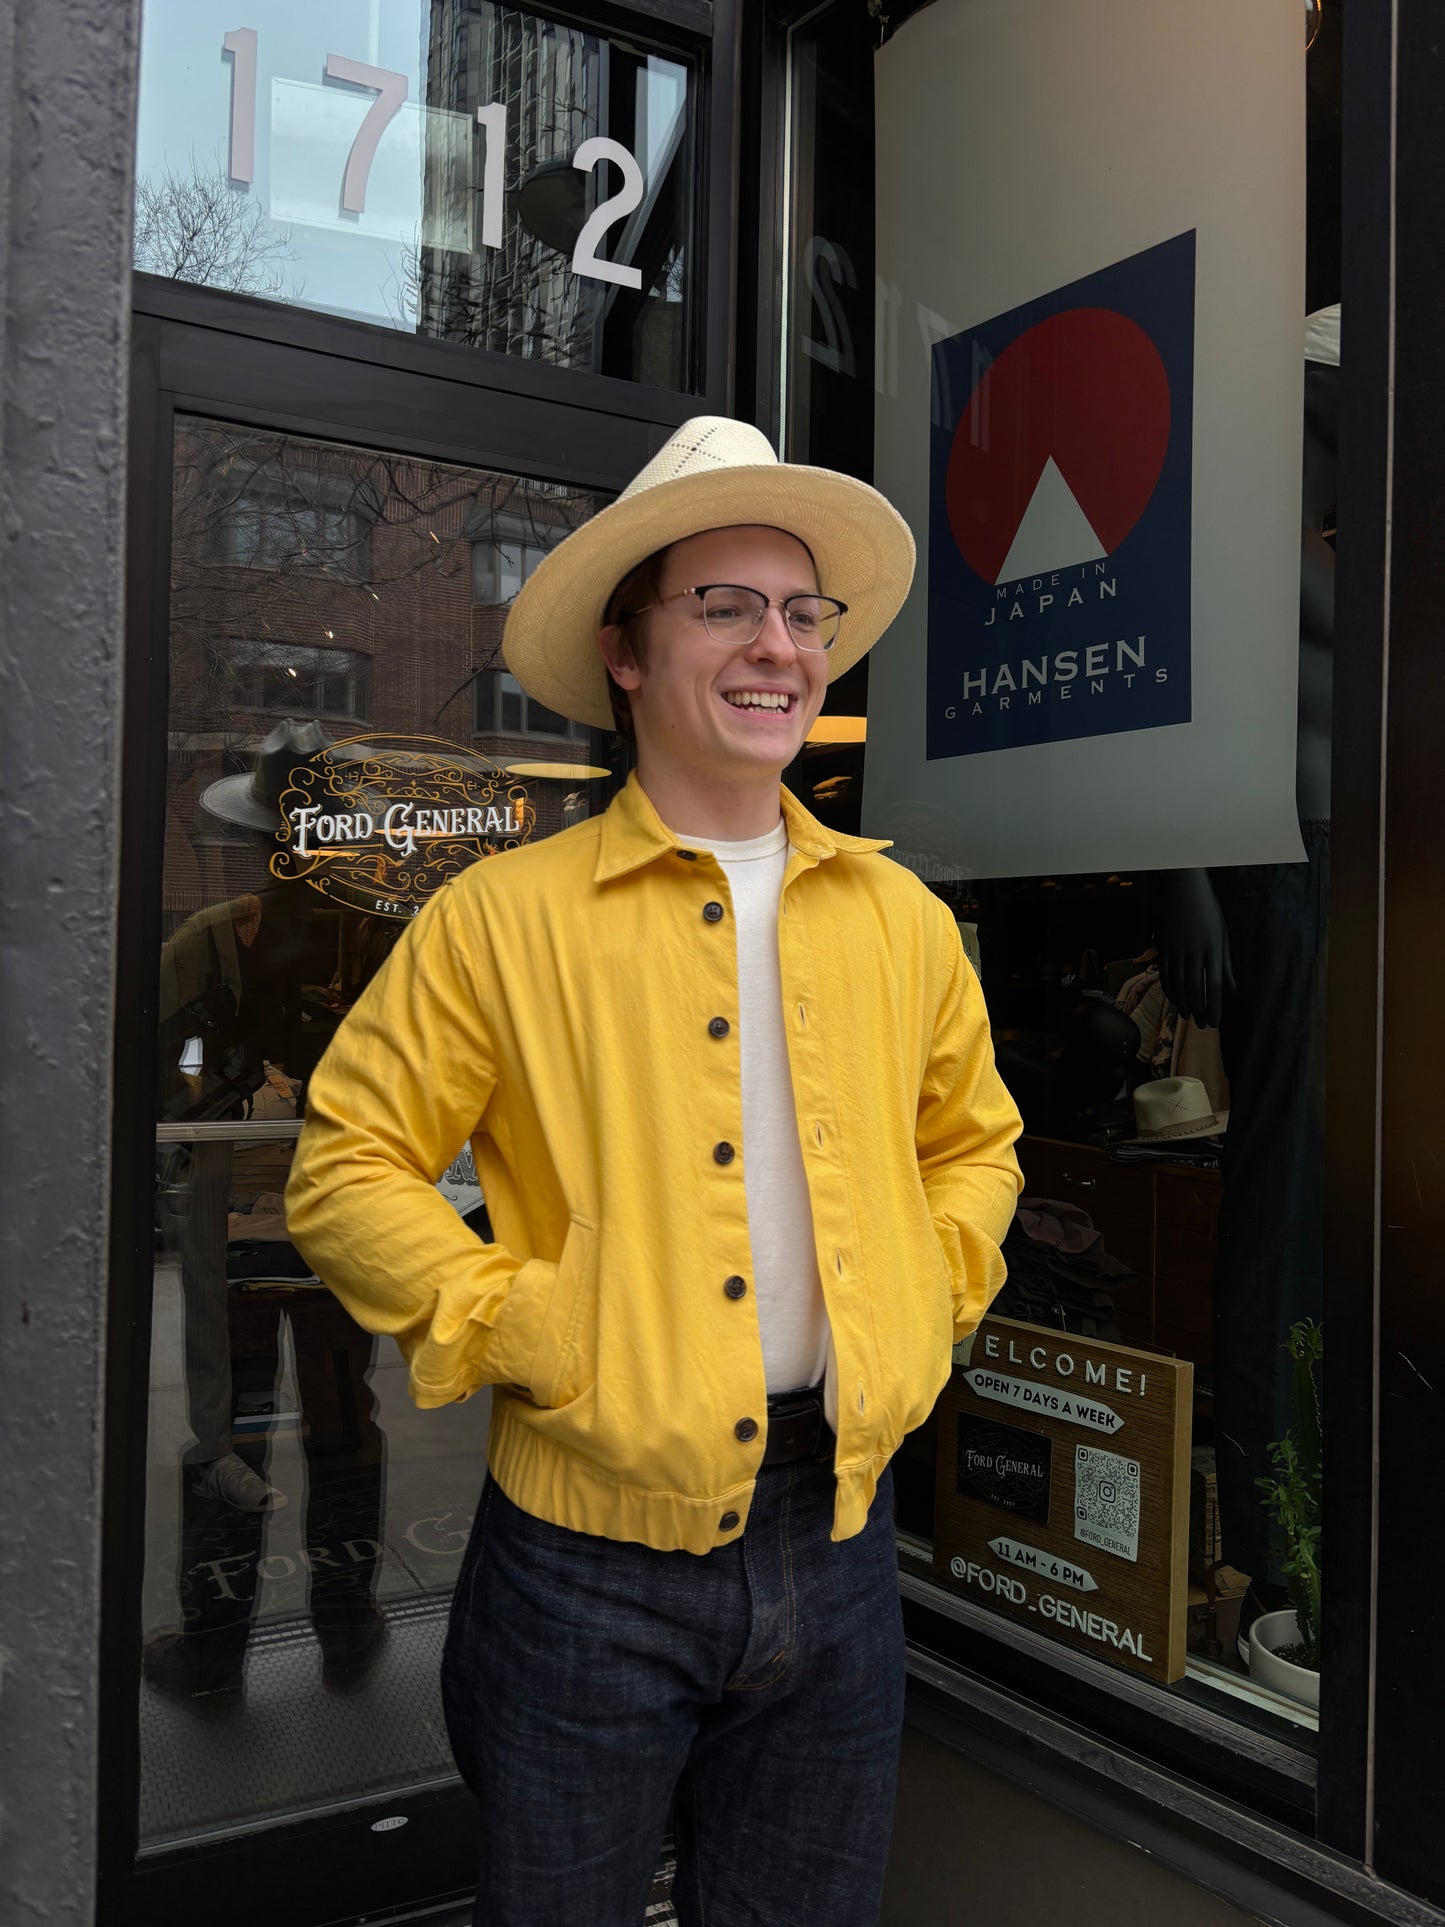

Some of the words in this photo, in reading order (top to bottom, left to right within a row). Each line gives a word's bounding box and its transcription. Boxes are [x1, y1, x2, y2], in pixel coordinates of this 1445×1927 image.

[223, 27, 644, 290] 1712
[984, 578, 1117, 626] JAPAN
[996, 573, 1061, 600] MADE
[1081, 562, 1106, 579] IN
[945, 668, 1169, 720] GARMENTS
[962, 636, 1146, 700] HANSEN
[289, 803, 374, 859] FORD
[384, 801, 521, 858] GENERAL
[375, 899, 402, 914] EST.
[972, 1331, 1147, 1397] ELCOME!
[974, 1373, 1011, 1394] OPEN
[1013, 1384, 1021, 1398] 7
[1022, 1388, 1059, 1411] DAYS
[1062, 1400, 1072, 1415] A
[1075, 1404, 1115, 1429] WEEK
[997, 1541, 1010, 1558] 11
[1014, 1549, 1037, 1568] AM
[1050, 1562, 1058, 1576] 6
[1063, 1567, 1084, 1587] PM
